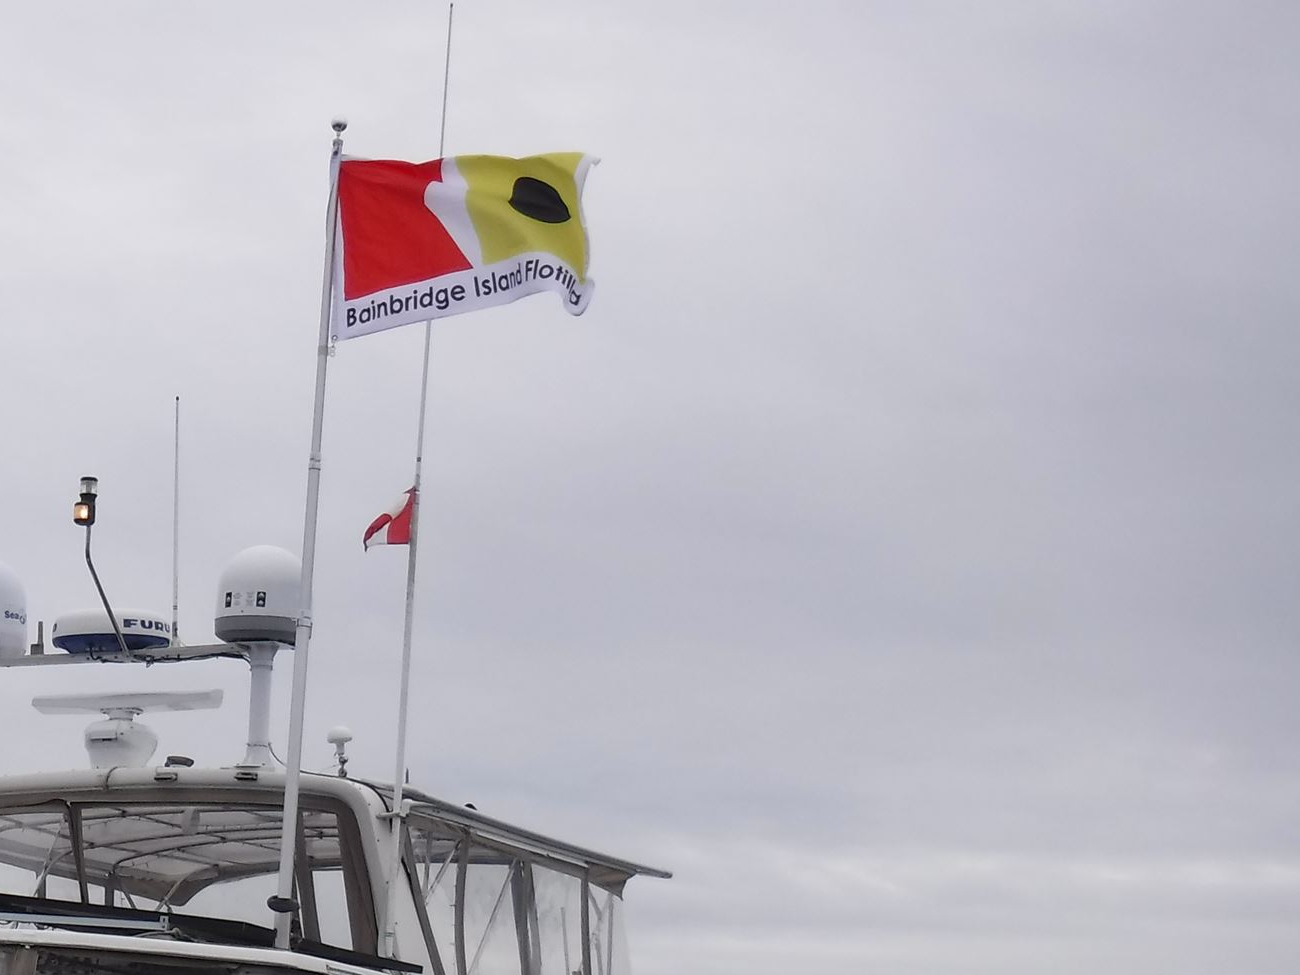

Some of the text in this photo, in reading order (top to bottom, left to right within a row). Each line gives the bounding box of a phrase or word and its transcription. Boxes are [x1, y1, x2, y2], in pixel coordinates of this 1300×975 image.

[346, 258, 582, 328] Bainbridge Island Flotilla
